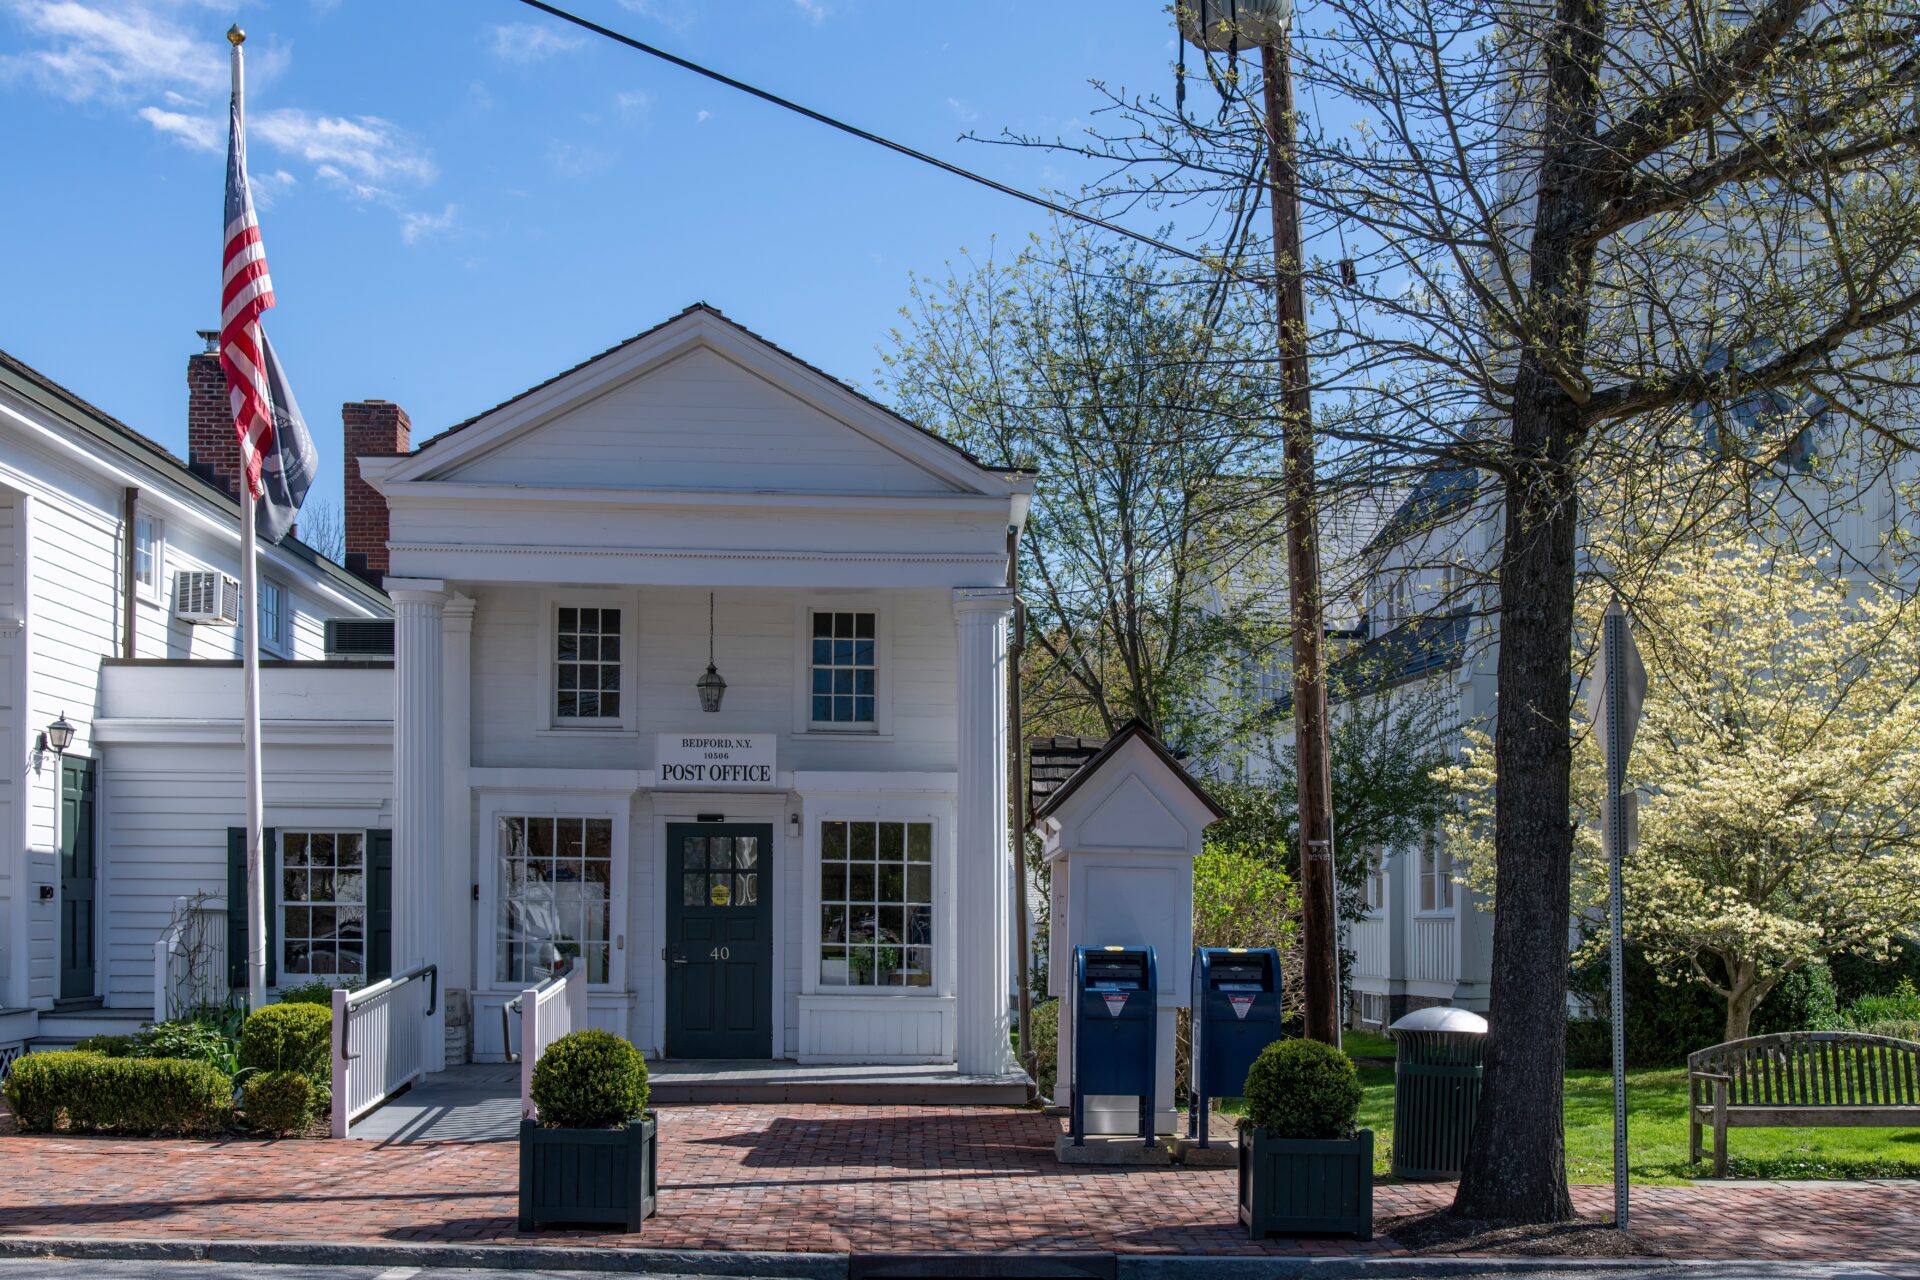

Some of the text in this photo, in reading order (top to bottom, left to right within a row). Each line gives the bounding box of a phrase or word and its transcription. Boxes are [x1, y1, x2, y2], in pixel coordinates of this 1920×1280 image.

[682, 739, 752, 749] BEDFORD, N.Y.
[704, 752, 729, 760] 10506
[661, 764, 771, 782] POST OFFICE
[710, 946, 729, 960] 40
